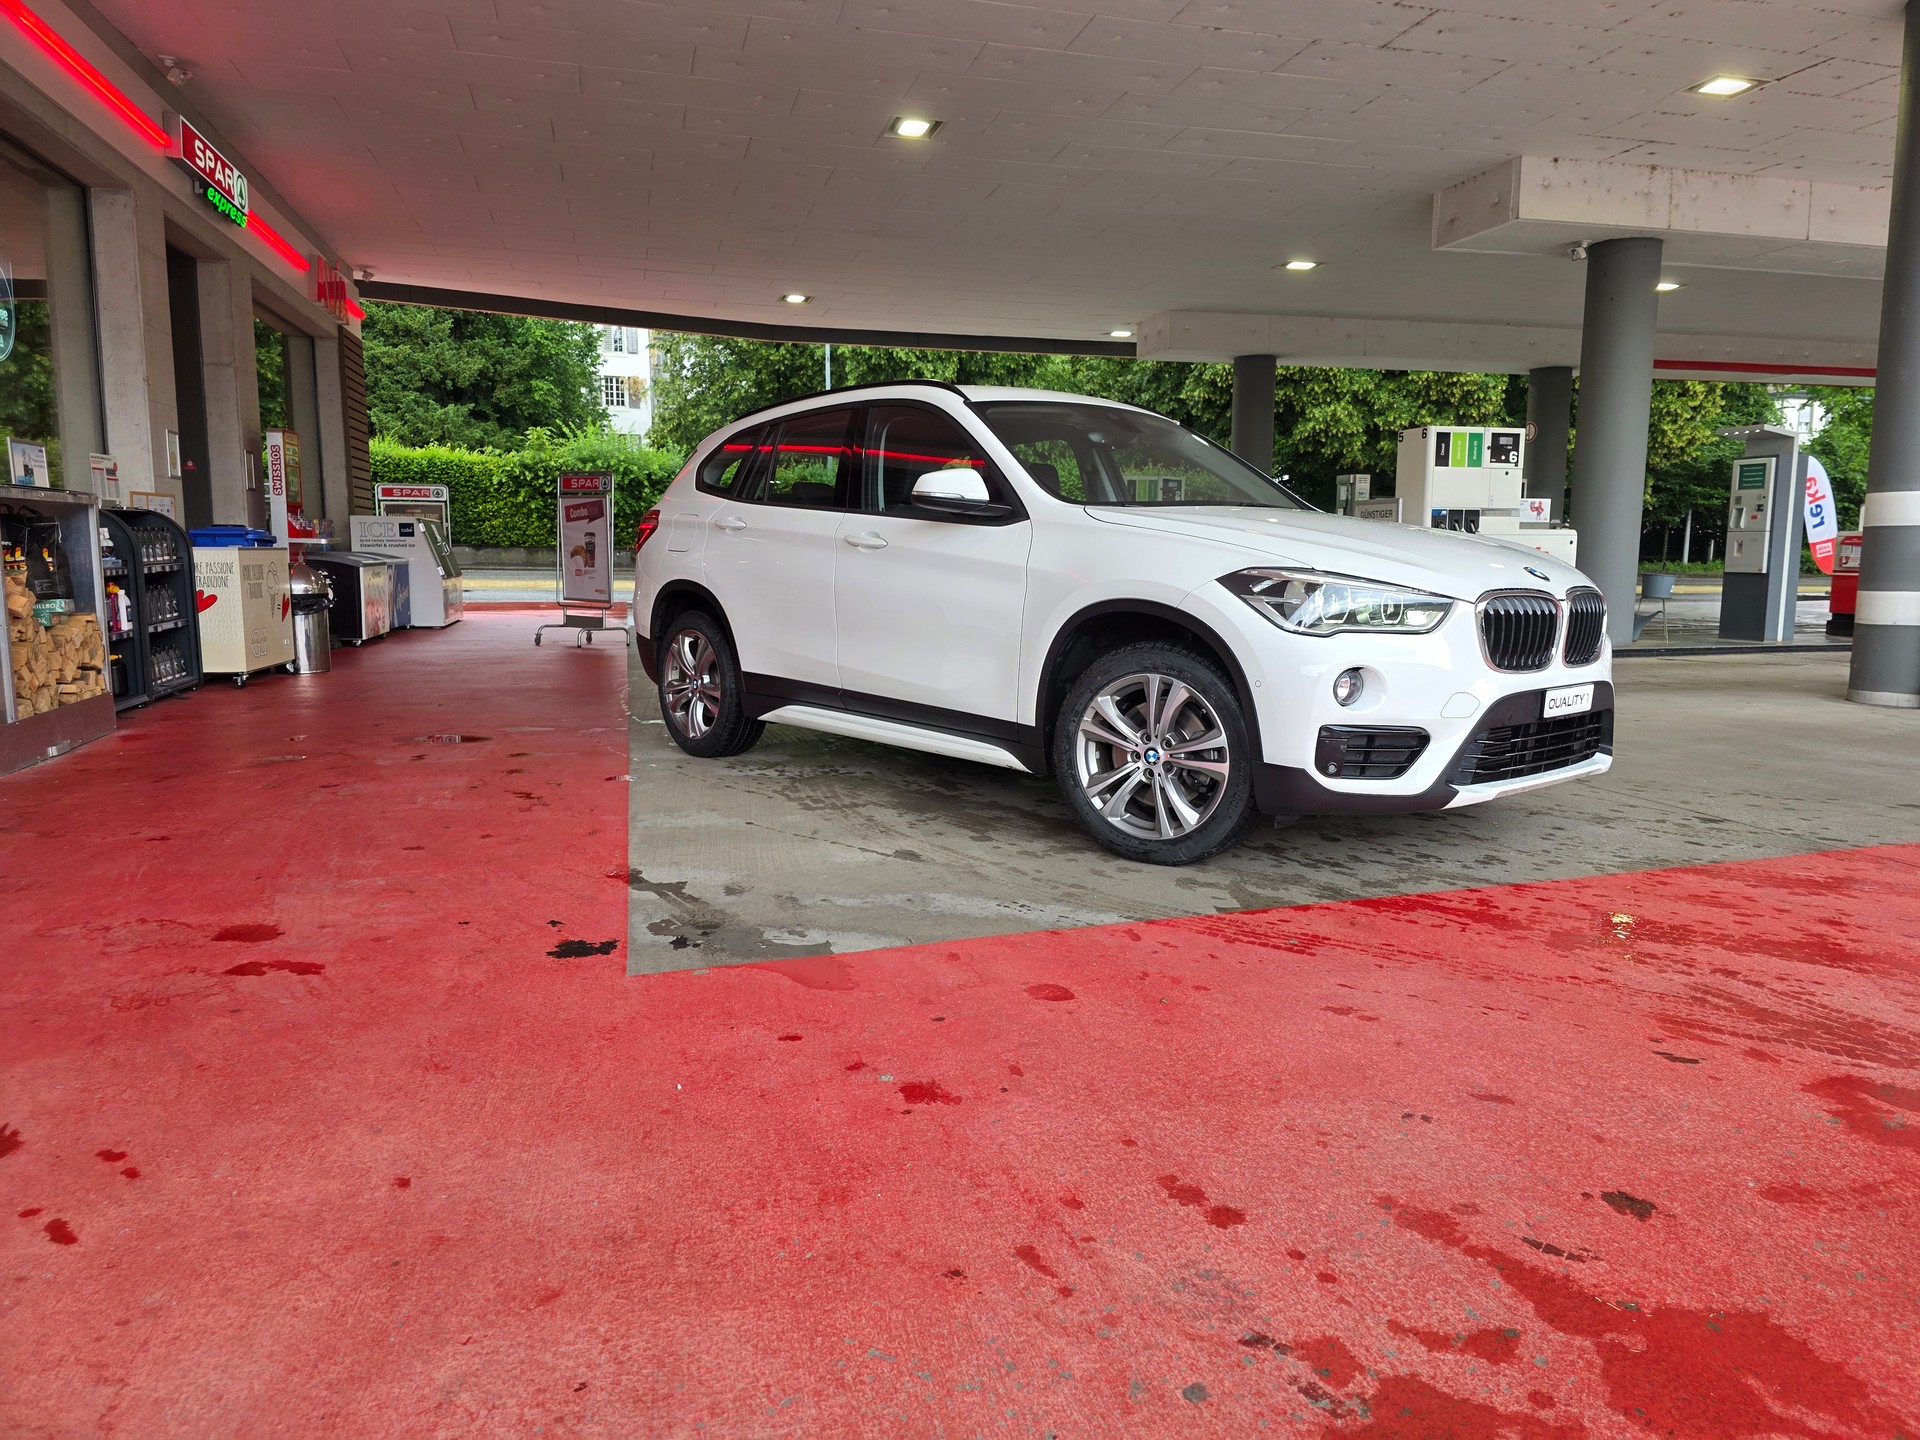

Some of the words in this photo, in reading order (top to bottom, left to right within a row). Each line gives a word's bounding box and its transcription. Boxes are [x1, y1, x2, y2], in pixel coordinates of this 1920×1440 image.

[195, 139, 234, 196] SPAR
[207, 187, 247, 228] express
[1398, 432, 1404, 443] 5
[1421, 428, 1428, 439] 6
[1509, 451, 1518, 463] 6
[270, 444, 283, 496] SWISSLOS
[571, 479, 599, 488] SPAR
[392, 488, 430, 497] SPAR
[1360, 509, 1393, 519] GÜNSTIGER
[359, 521, 396, 538] ICE
[205, 561, 235, 575] PASSIONE
[196, 575, 229, 588] TRADIZIONE
[1548, 693, 1585, 710] QUALITY
